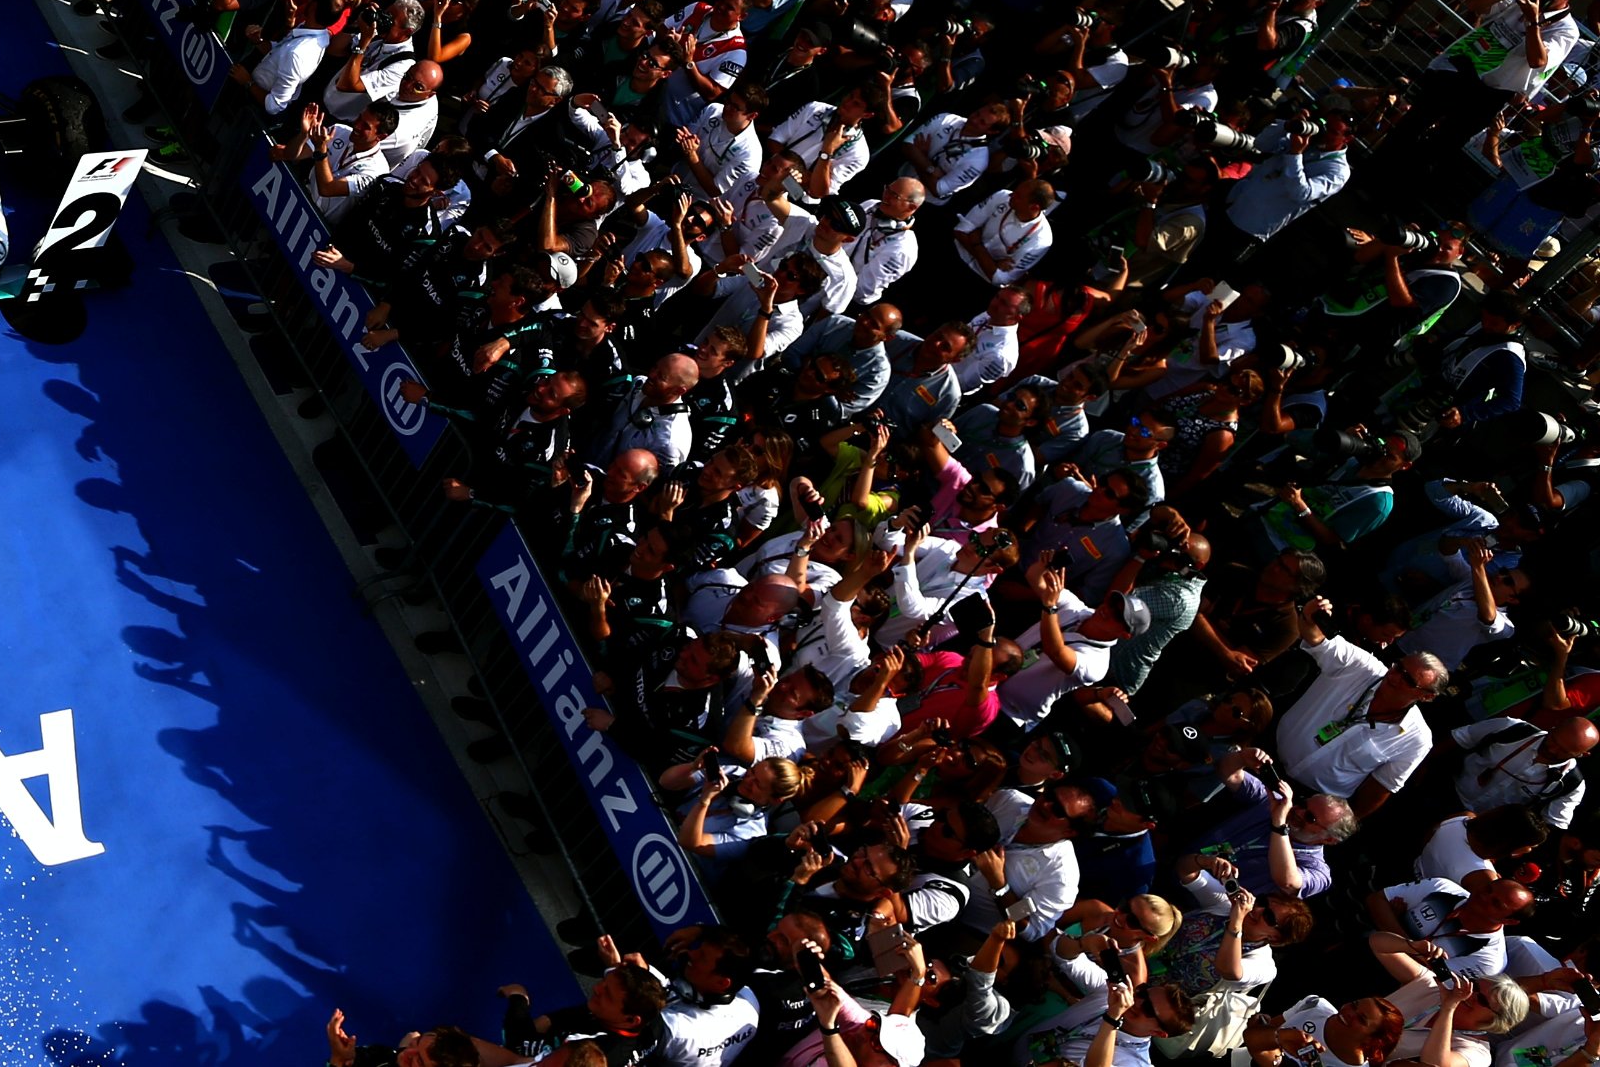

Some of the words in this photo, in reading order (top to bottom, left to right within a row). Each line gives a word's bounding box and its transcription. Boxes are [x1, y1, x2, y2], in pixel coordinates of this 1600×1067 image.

[34, 192, 122, 264] 2
[490, 554, 638, 833] Allianz
[697, 1028, 754, 1058] PETRONAS
